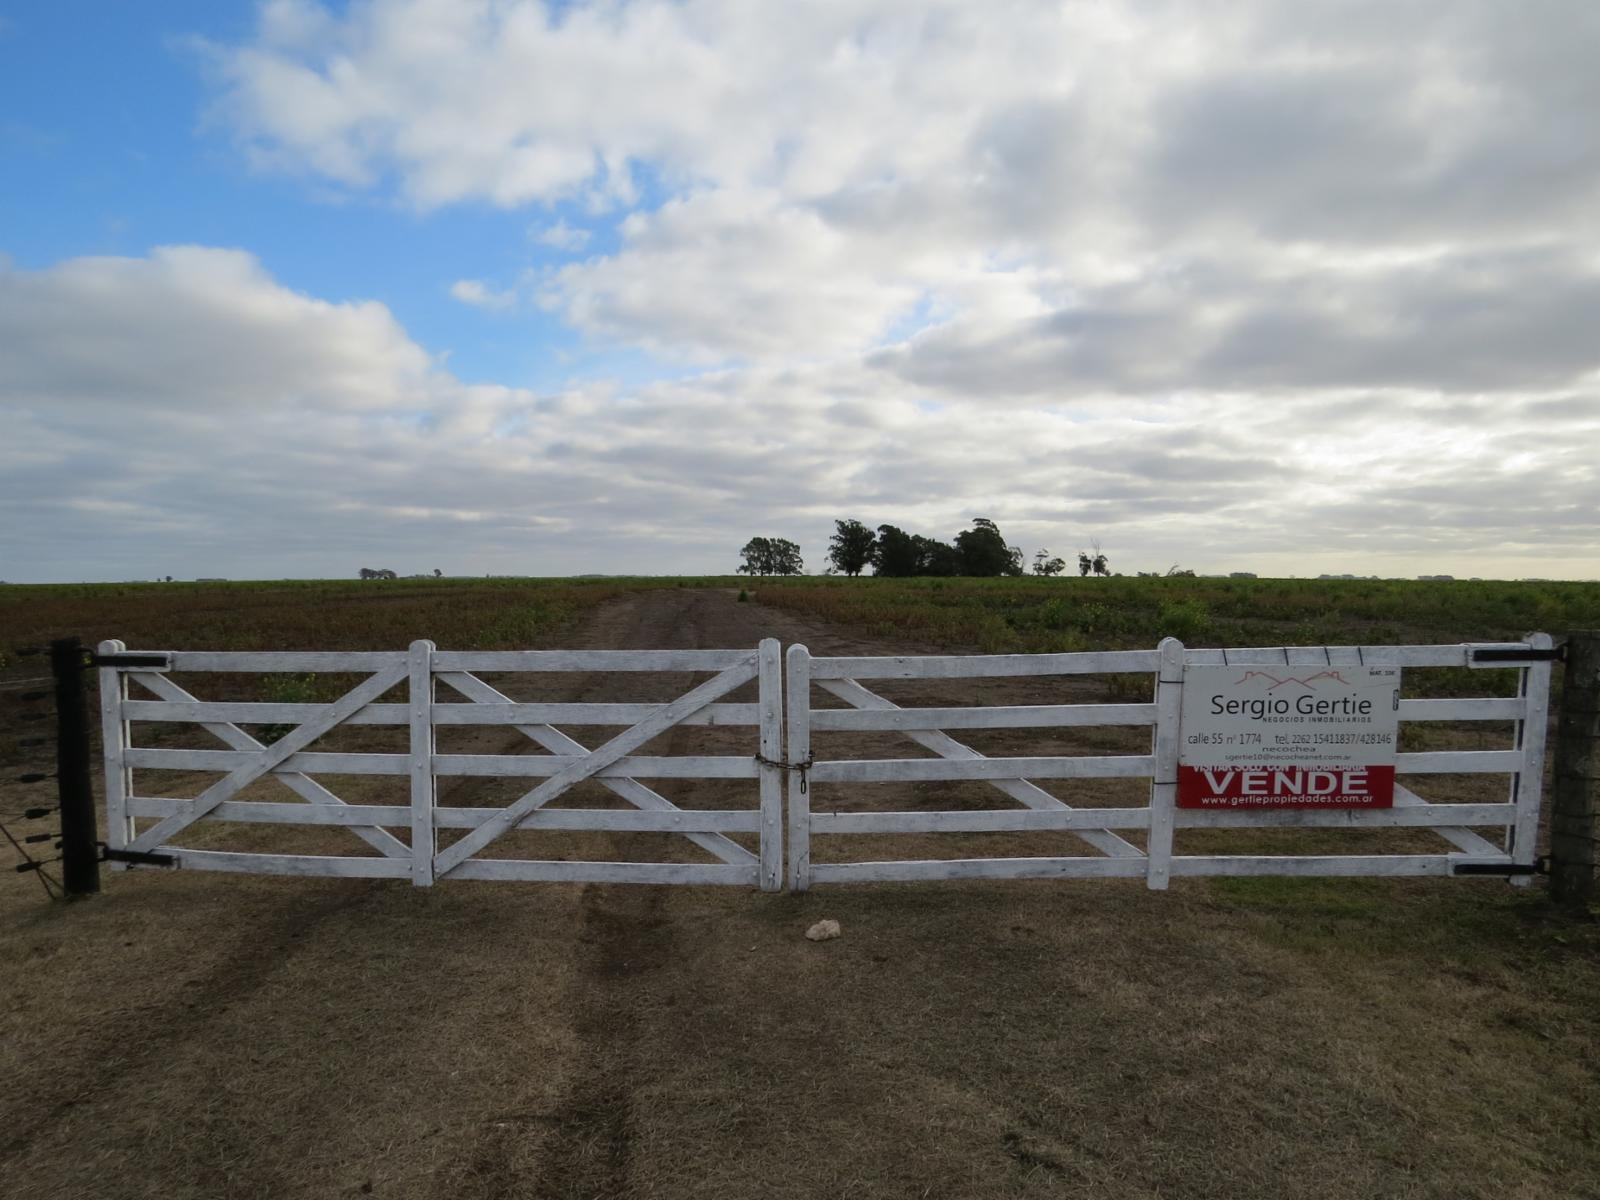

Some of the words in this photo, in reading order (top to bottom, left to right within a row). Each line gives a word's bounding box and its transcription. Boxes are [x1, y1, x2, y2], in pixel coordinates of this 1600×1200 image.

[1211, 692, 1289, 720] Sergio
[1296, 693, 1372, 715] Gertie
[1187, 732, 1209, 744] calle
[1211, 732, 1223, 744] 55
[1239, 733, 1262, 745] 1774
[1291, 734, 1311, 744] 2262
[1262, 745, 1316, 753] necochea
[1204, 771, 1369, 795] VENDE
[1201, 794, 1374, 806] www.gertiepropiedades.com.ar
